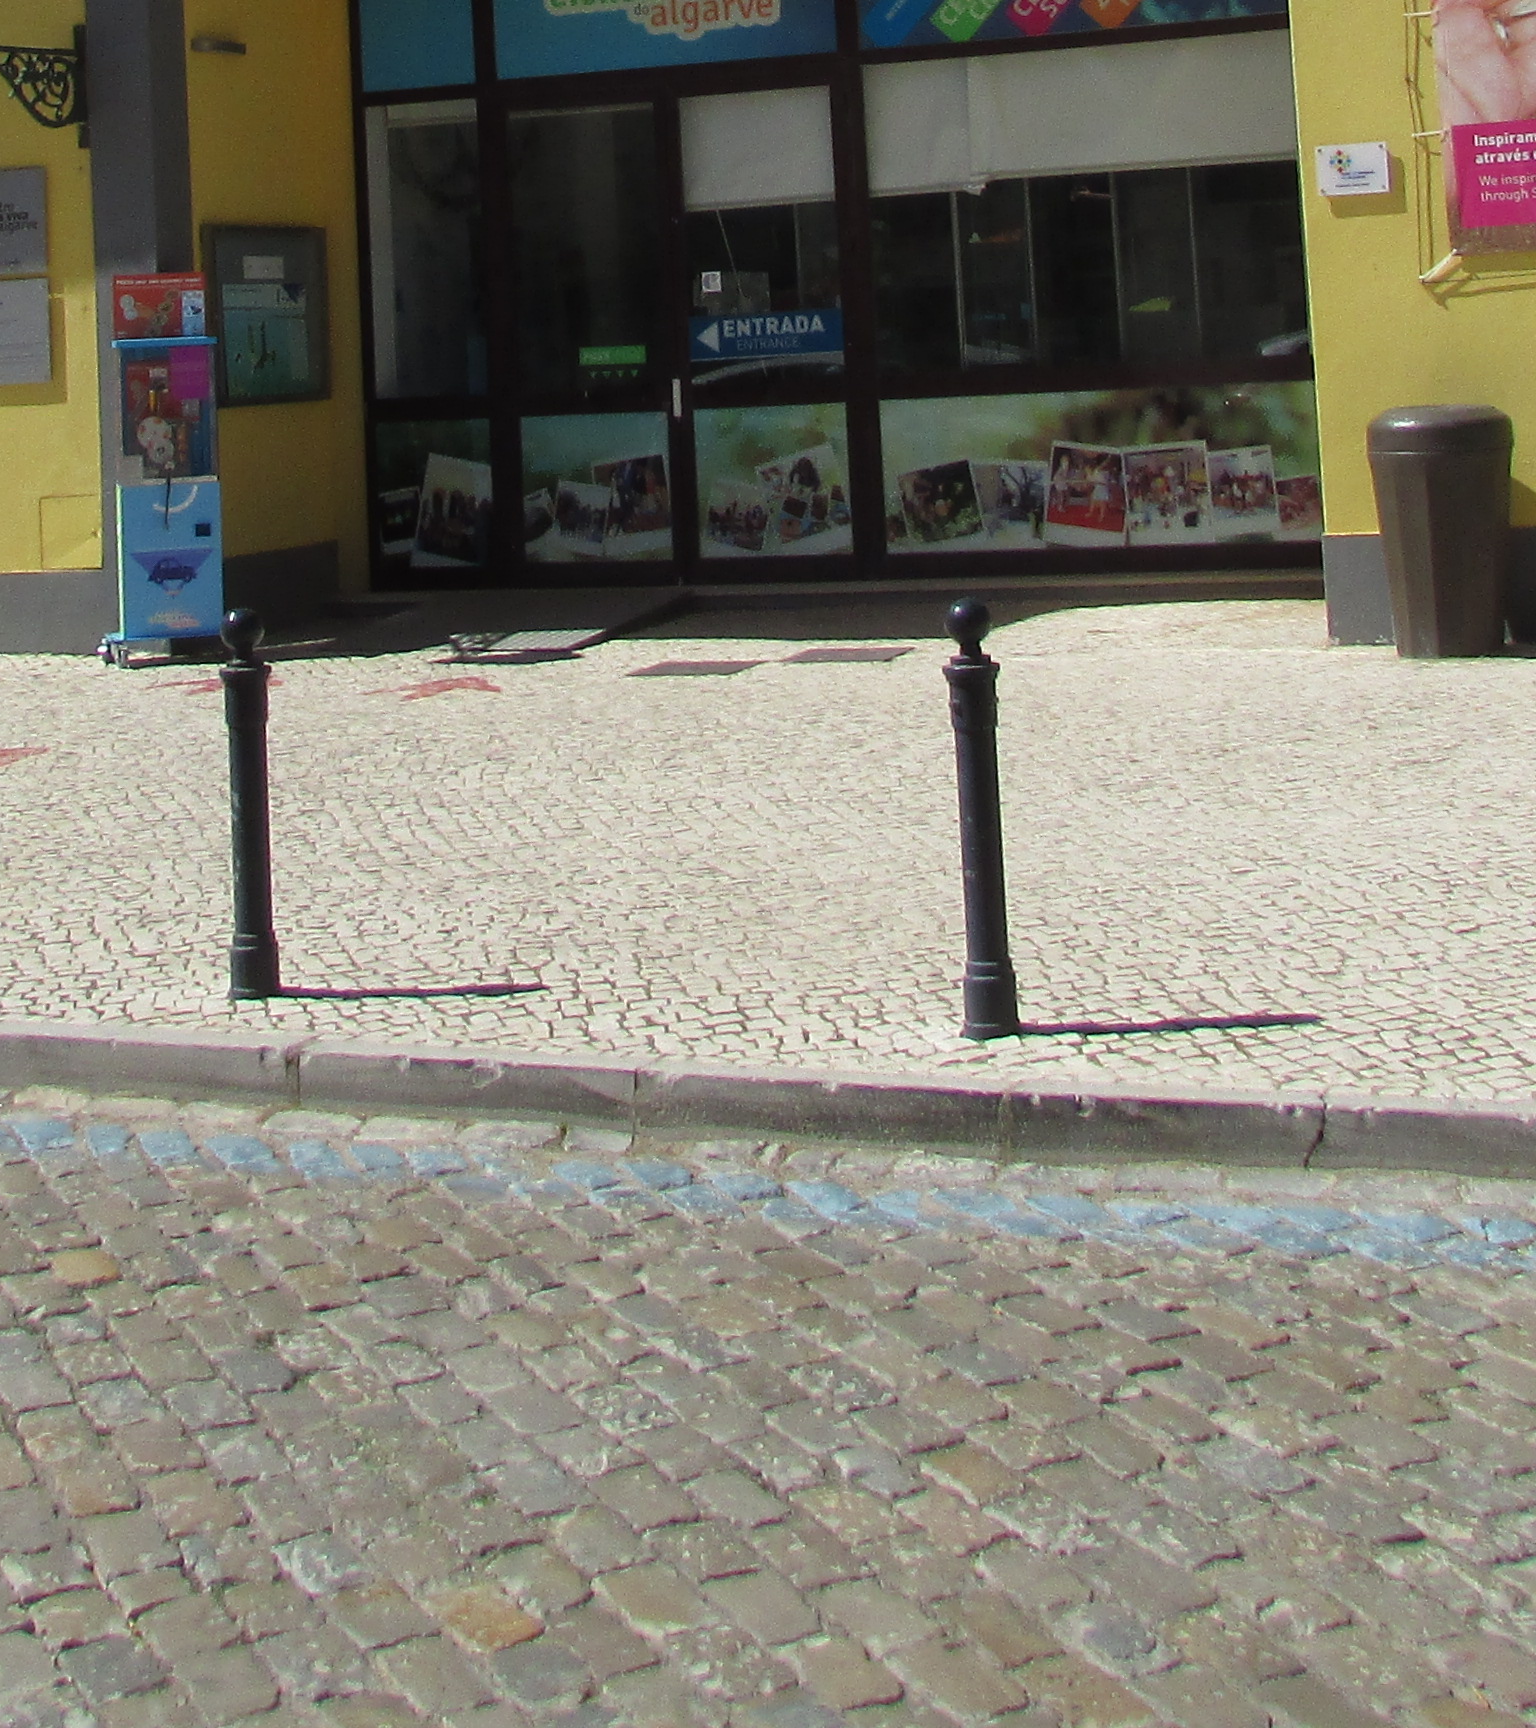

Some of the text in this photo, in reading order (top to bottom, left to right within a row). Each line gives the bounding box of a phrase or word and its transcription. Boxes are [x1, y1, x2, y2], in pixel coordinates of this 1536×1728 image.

[1475, 148, 1530, 165] através
[1479, 175, 1498, 186] We
[1480, 186, 1529, 203] through
[723, 315, 826, 338] ENTRADA
[737, 337, 800, 351] ENTRANCE
